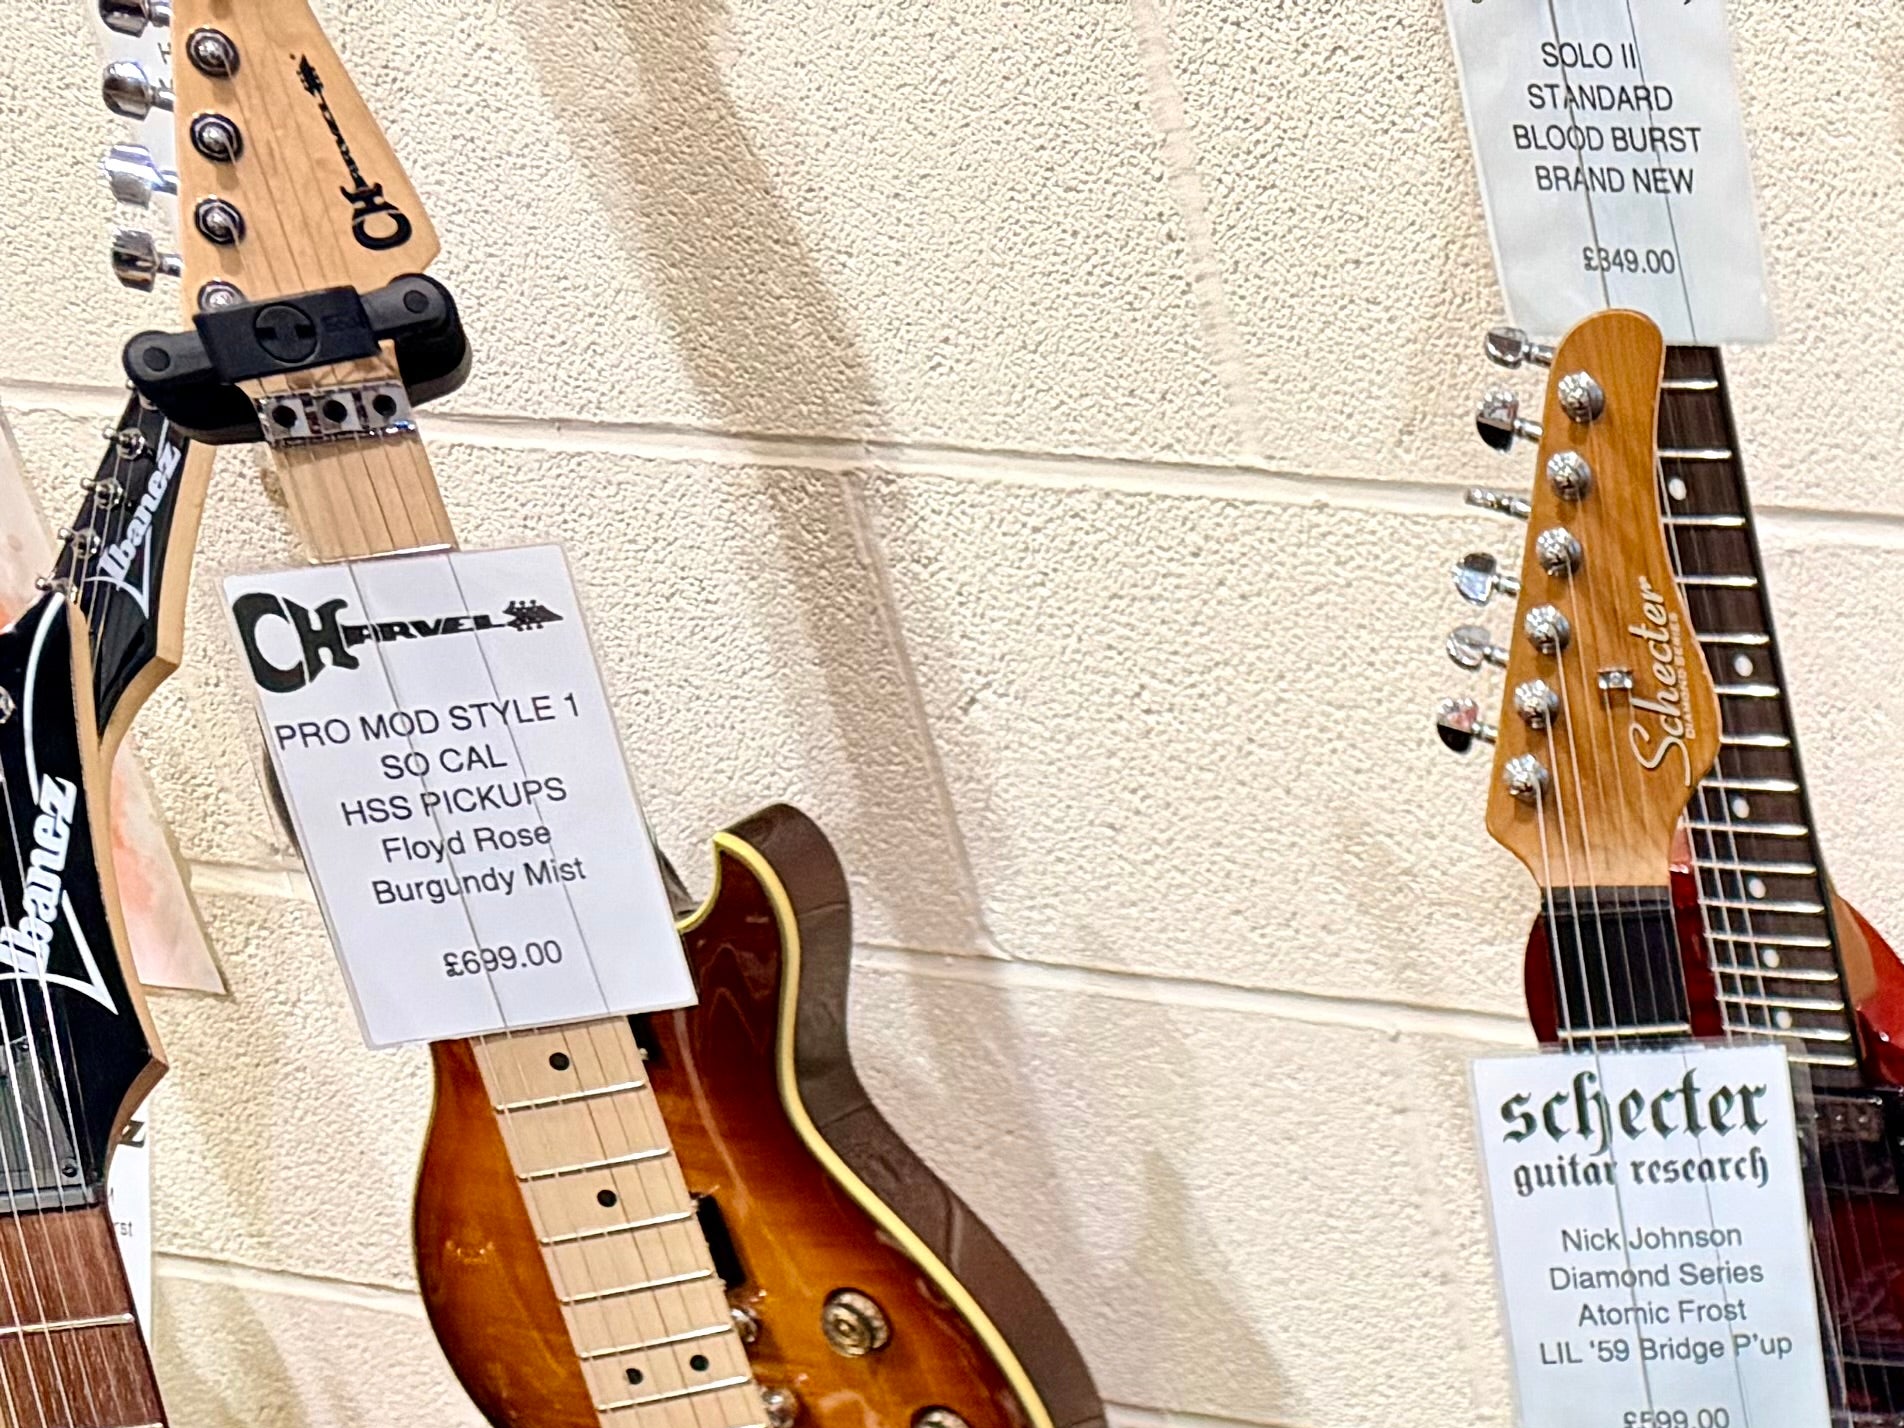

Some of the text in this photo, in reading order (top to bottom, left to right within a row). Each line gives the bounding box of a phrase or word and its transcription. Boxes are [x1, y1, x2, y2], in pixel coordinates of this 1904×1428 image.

[1541, 42, 1613, 69] SOLO
[1527, 83, 1674, 111] STANDARD
[1513, 124, 1701, 153] BLOOD BURST
[1535, 165, 1694, 194] BRAND NEW
[98, 441, 182, 592] Ibanez
[1627, 575, 1692, 787] Schecter
[275, 692, 581, 751] PRO MOD STYLE 1
[380, 743, 508, 780] SO CAL
[341, 777, 568, 827] HSS PICKUPS
[381, 824, 552, 864] Floyd Rose
[0, 772, 77, 976] Ibanez
[372, 857, 587, 905] Burgundy Mist
[443, 939, 563, 978] £699.00
[1500, 1067, 1768, 1156] schecter
[1513, 1145, 1770, 1197] guitar research
[1561, 1225, 1743, 1252] Nick Johnson
[1549, 1260, 1765, 1290] Diamond Series
[1578, 1298, 1747, 1327] Atomic Frost
[1540, 1340, 1582, 1365] LIL
[1641, 1340, 1725, 1366] Bridge
